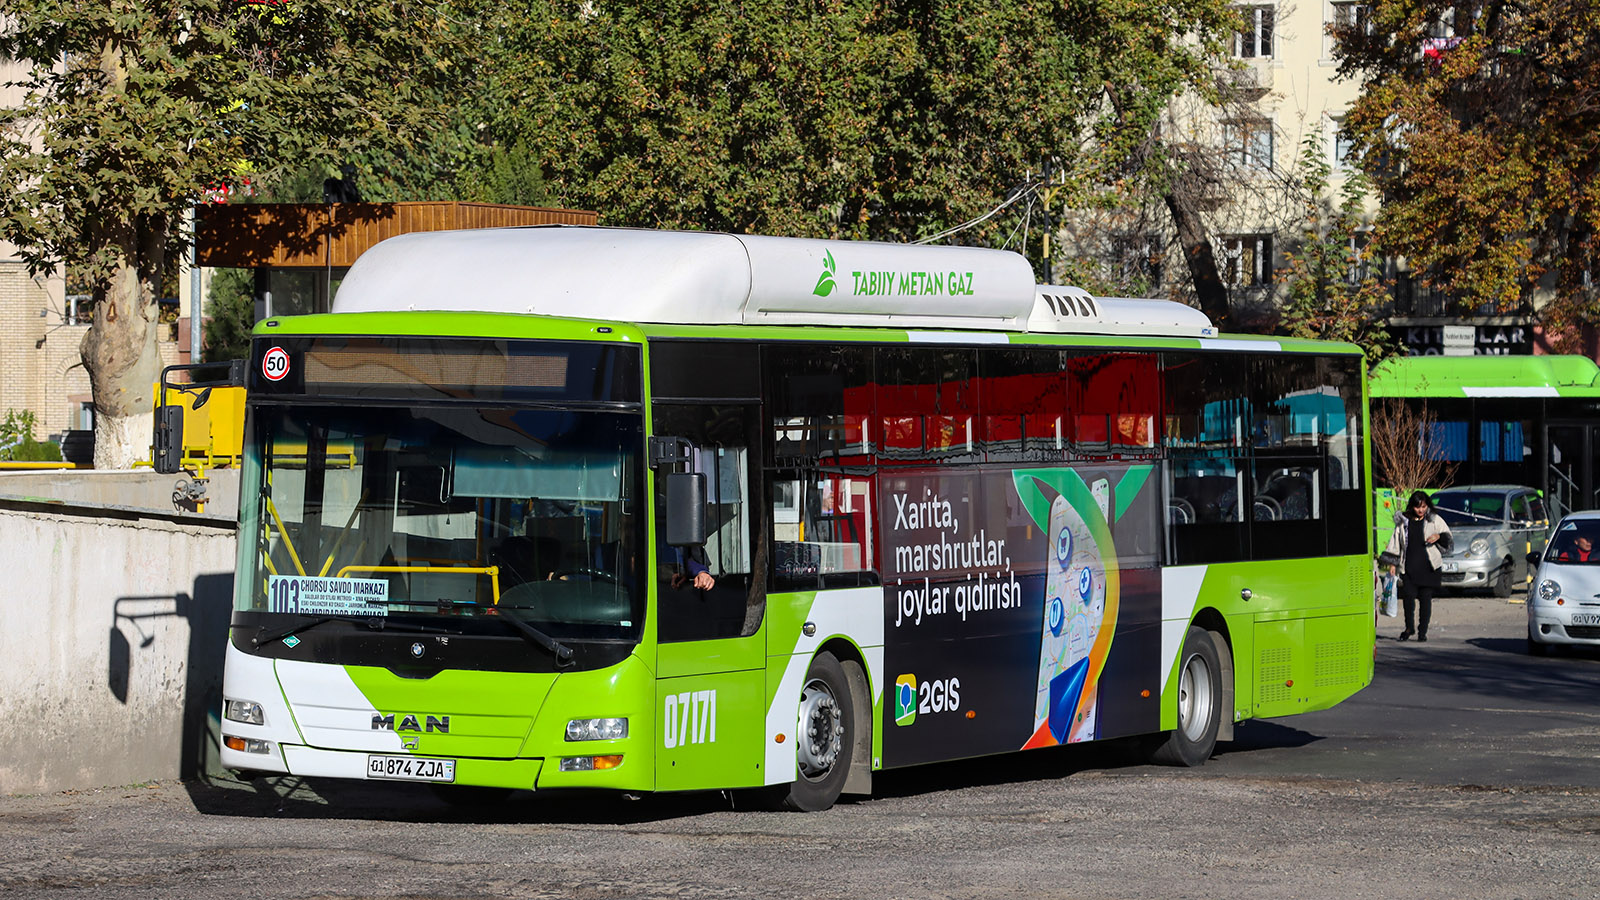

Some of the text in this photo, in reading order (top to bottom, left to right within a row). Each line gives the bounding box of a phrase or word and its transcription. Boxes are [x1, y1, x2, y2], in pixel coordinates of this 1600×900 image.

[852, 271, 974, 296] TABIIY METAN GAZ
[1408, 327, 1526, 344] KITLAR
[267, 356, 286, 372] 50
[893, 489, 959, 534] Xarita,
[896, 529, 1010, 573] marshrutlar,
[271, 579, 300, 613] 103
[300, 580, 385, 595] CHORSU SAVDO MARKAZI
[895, 570, 1021, 627] joylar qidirish
[919, 677, 960, 715] 2GIS
[371, 713, 450, 734] MAN
[664, 689, 716, 748] 07171
[371, 759, 384, 773] 01
[386, 759, 412, 776] 874
[415, 761, 444, 778] ZJA
